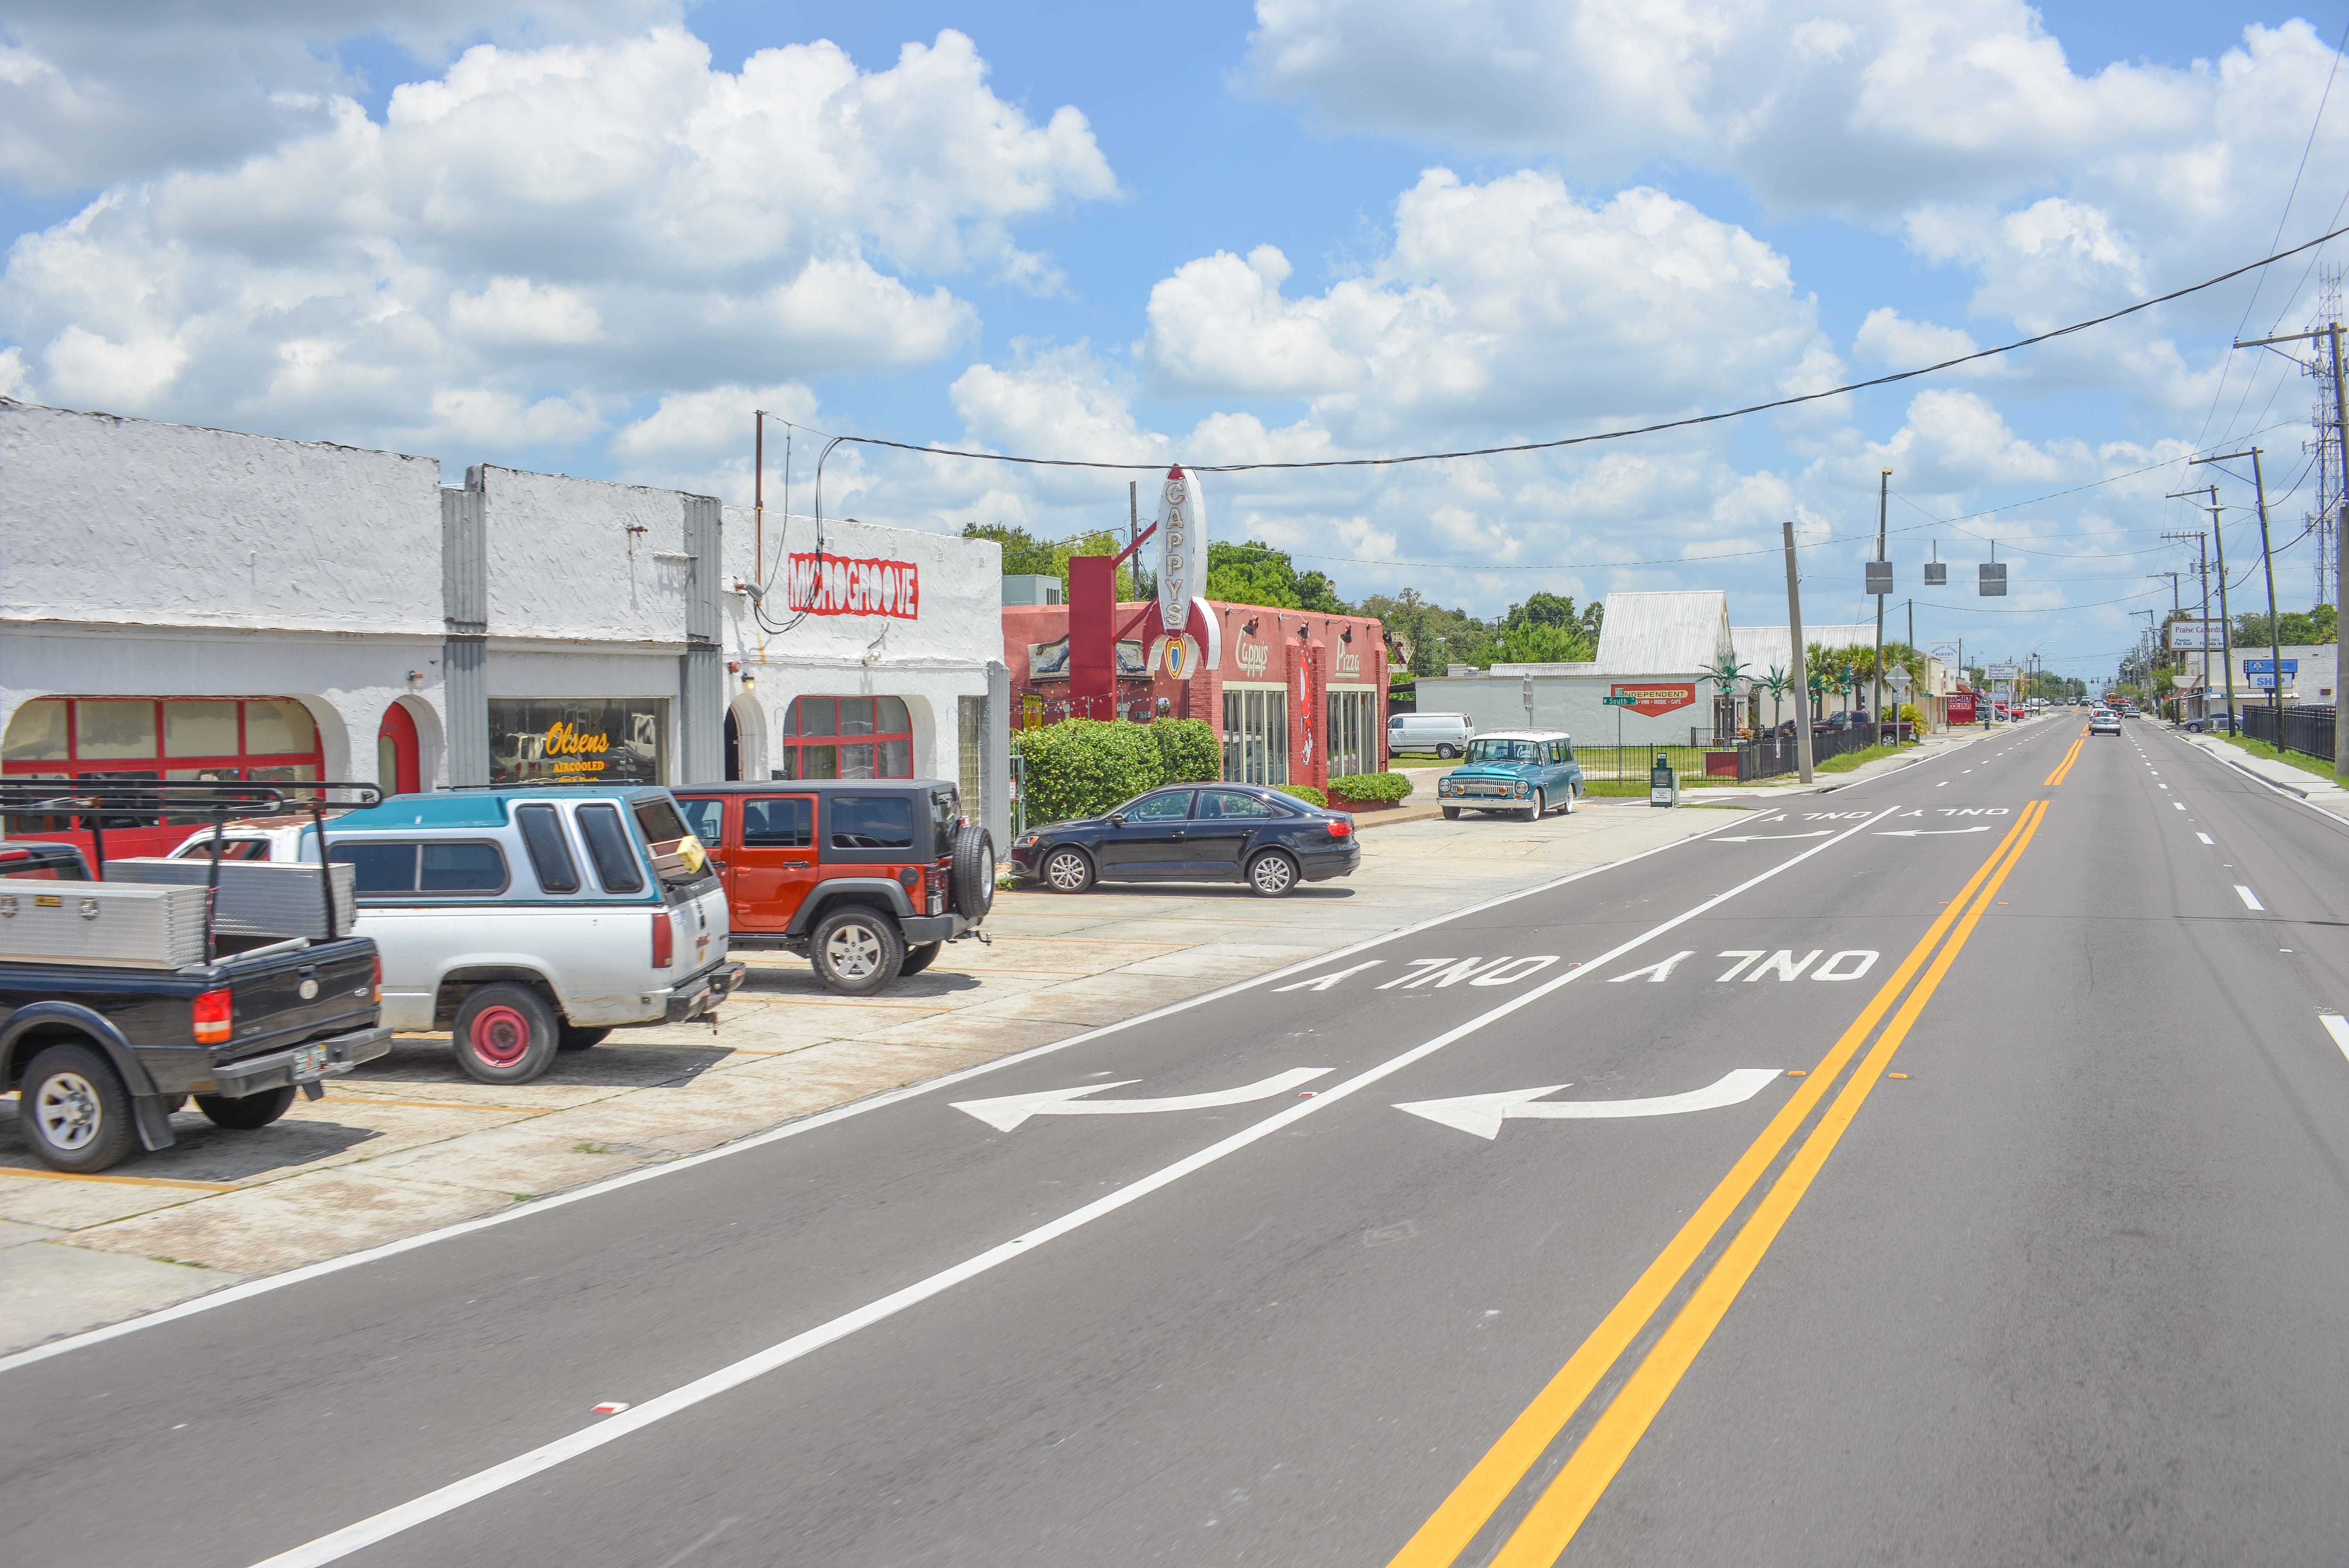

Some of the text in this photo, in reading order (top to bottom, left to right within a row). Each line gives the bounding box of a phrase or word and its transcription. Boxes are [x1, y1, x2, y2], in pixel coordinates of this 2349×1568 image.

[1165, 483, 1185, 625] CAPPYS
[790, 557, 916, 615] MICROGROOVE
[1235, 623, 1269, 679] Cappy's
[1336, 634, 1360, 672] Pizza
[545, 722, 610, 755] Olsens
[552, 761, 605, 773] AIRCOOLED
